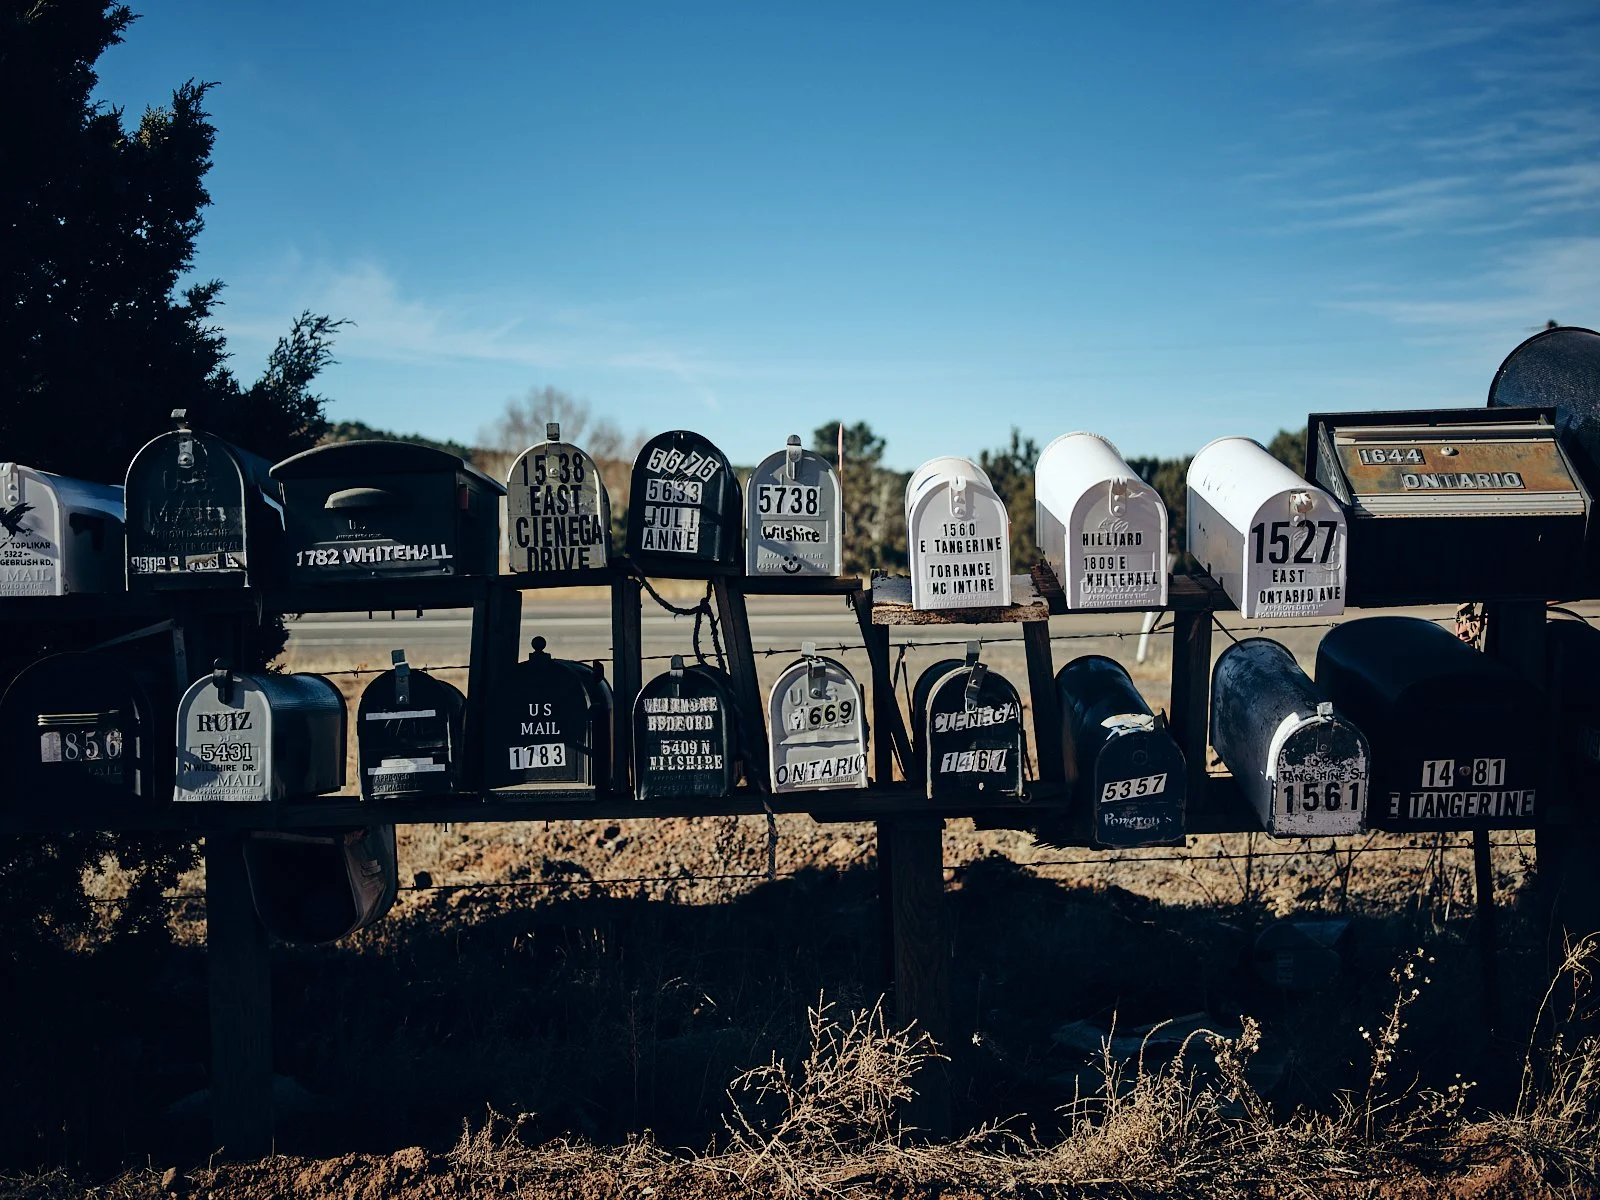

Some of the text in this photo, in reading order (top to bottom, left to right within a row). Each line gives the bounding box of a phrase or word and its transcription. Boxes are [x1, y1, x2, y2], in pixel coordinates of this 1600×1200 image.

[649, 450, 717, 479] 5676
[1360, 448, 1423, 464] 1644
[521, 452, 585, 486] 1538
[1403, 472, 1522, 489] ONTARIO
[529, 484, 582, 516] EAST
[648, 480, 700, 503] 5633
[758, 487, 819, 515] 5738
[515, 515, 603, 548] CIENEGA
[762, 526, 820, 543] Wilshire
[943, 523, 976, 537] 1560
[1082, 532, 1143, 546] HILLIARD
[11, 541, 51, 550] TOPLIKAR
[643, 529, 696, 551] ANNE
[920, 537, 1002, 555] E TANGERINE
[1251, 520, 1338, 564] 1527
[0, 559, 39, 567] GEBRUSH
[4, 550, 23, 558] 5322
[296, 543, 453, 566] 1782 WHITEHALL
[526, 546, 591, 573] DRIVE
[1084, 556, 1126, 570] 1809 E
[929, 562, 991, 578] TORRANCE
[1272, 569, 1305, 583] EAST
[932, 579, 995, 595] MC INTIRE
[1320, 586, 1341, 601] AVE
[196, 711, 252, 732] RUIZ
[934, 702, 1019, 733] CIENEGA
[520, 721, 561, 735] MAIL
[200, 742, 252, 762] 5431
[513, 745, 562, 767] 1783
[661, 740, 711, 755] 5409 N
[242, 763, 256, 772] DR.
[776, 753, 866, 785] ONTARIO
[217, 774, 262, 787] MAIL
[1104, 775, 1164, 801] 5357
[1283, 782, 1360, 814] 1561
[1389, 791, 1535, 818] E TANGERINE
